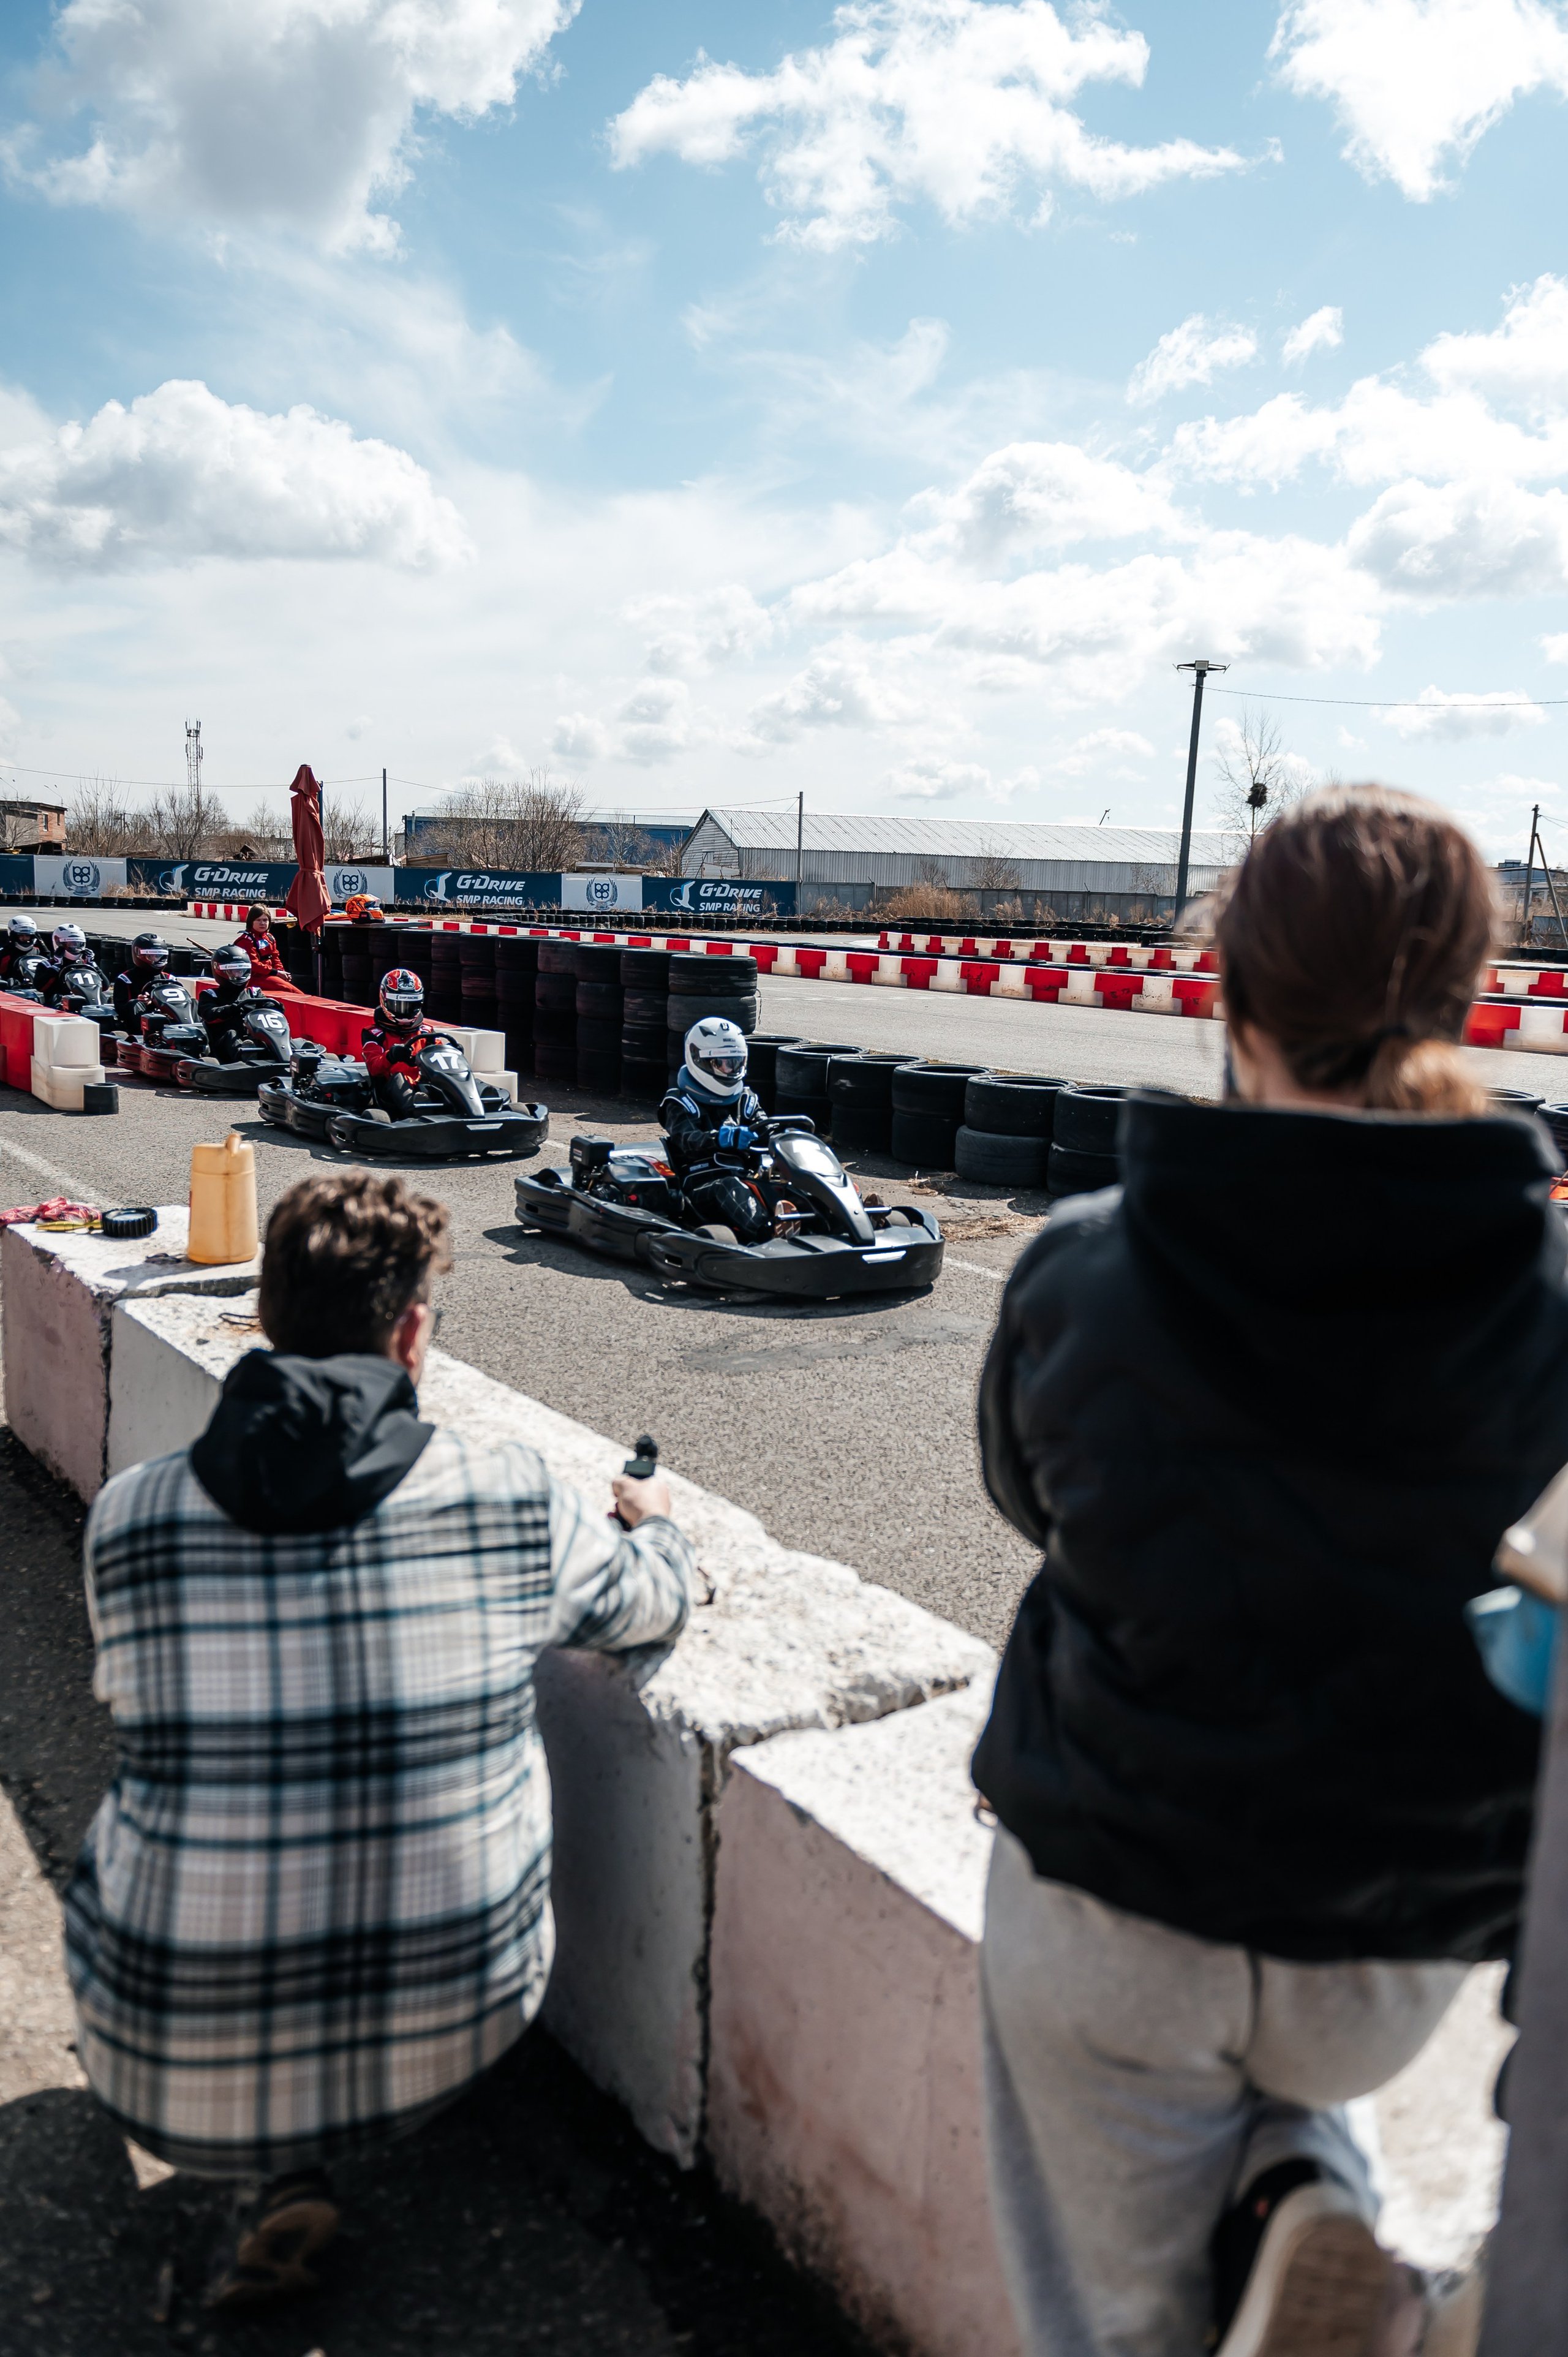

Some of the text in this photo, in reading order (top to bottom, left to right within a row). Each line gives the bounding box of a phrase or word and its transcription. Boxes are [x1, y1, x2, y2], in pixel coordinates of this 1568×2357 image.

[195, 887, 266, 898] SMP RACING
[456, 895, 523, 905] SMP RACING
[699, 902, 722, 911] SMP
[73, 973, 95, 984] 11
[162, 988, 186, 1001] 9
[257, 1014, 283, 1028] 16
[429, 1052, 459, 1069] 17
